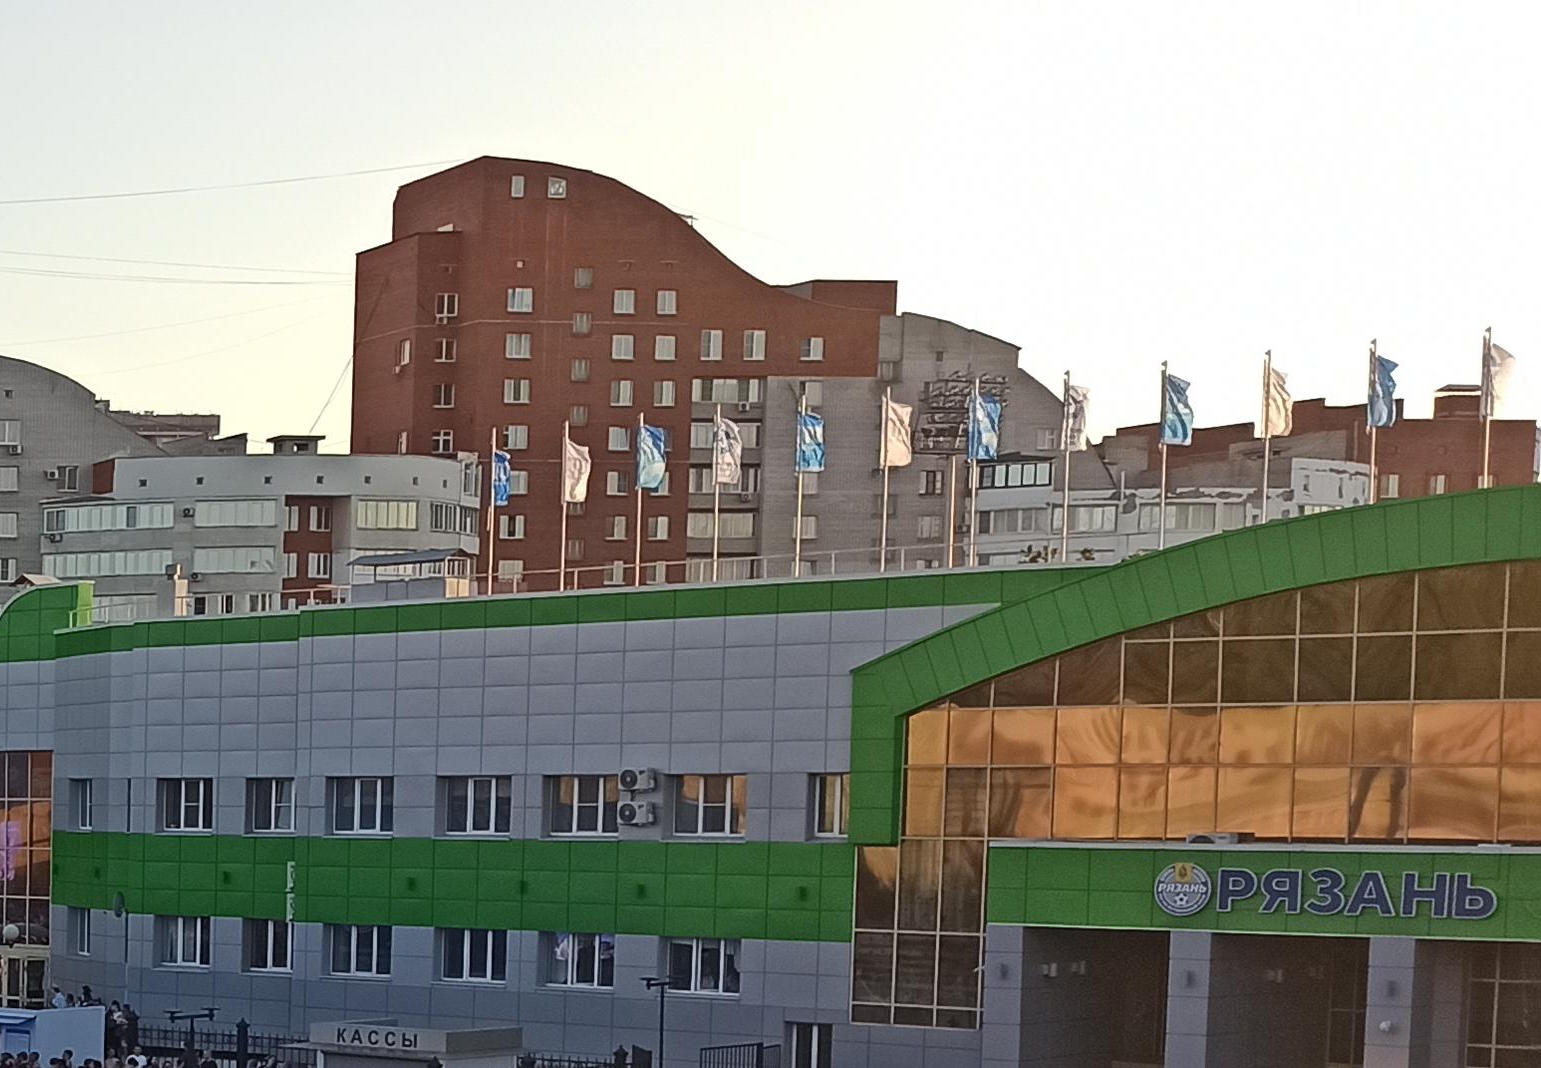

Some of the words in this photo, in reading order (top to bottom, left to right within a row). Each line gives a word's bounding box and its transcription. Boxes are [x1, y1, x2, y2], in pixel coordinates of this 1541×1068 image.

[1158, 883, 1207, 893] РЯЗАНЬ
[1215, 867, 1498, 919] РЯЗАНЬ
[336, 1027, 418, 1049] КАССЫ
